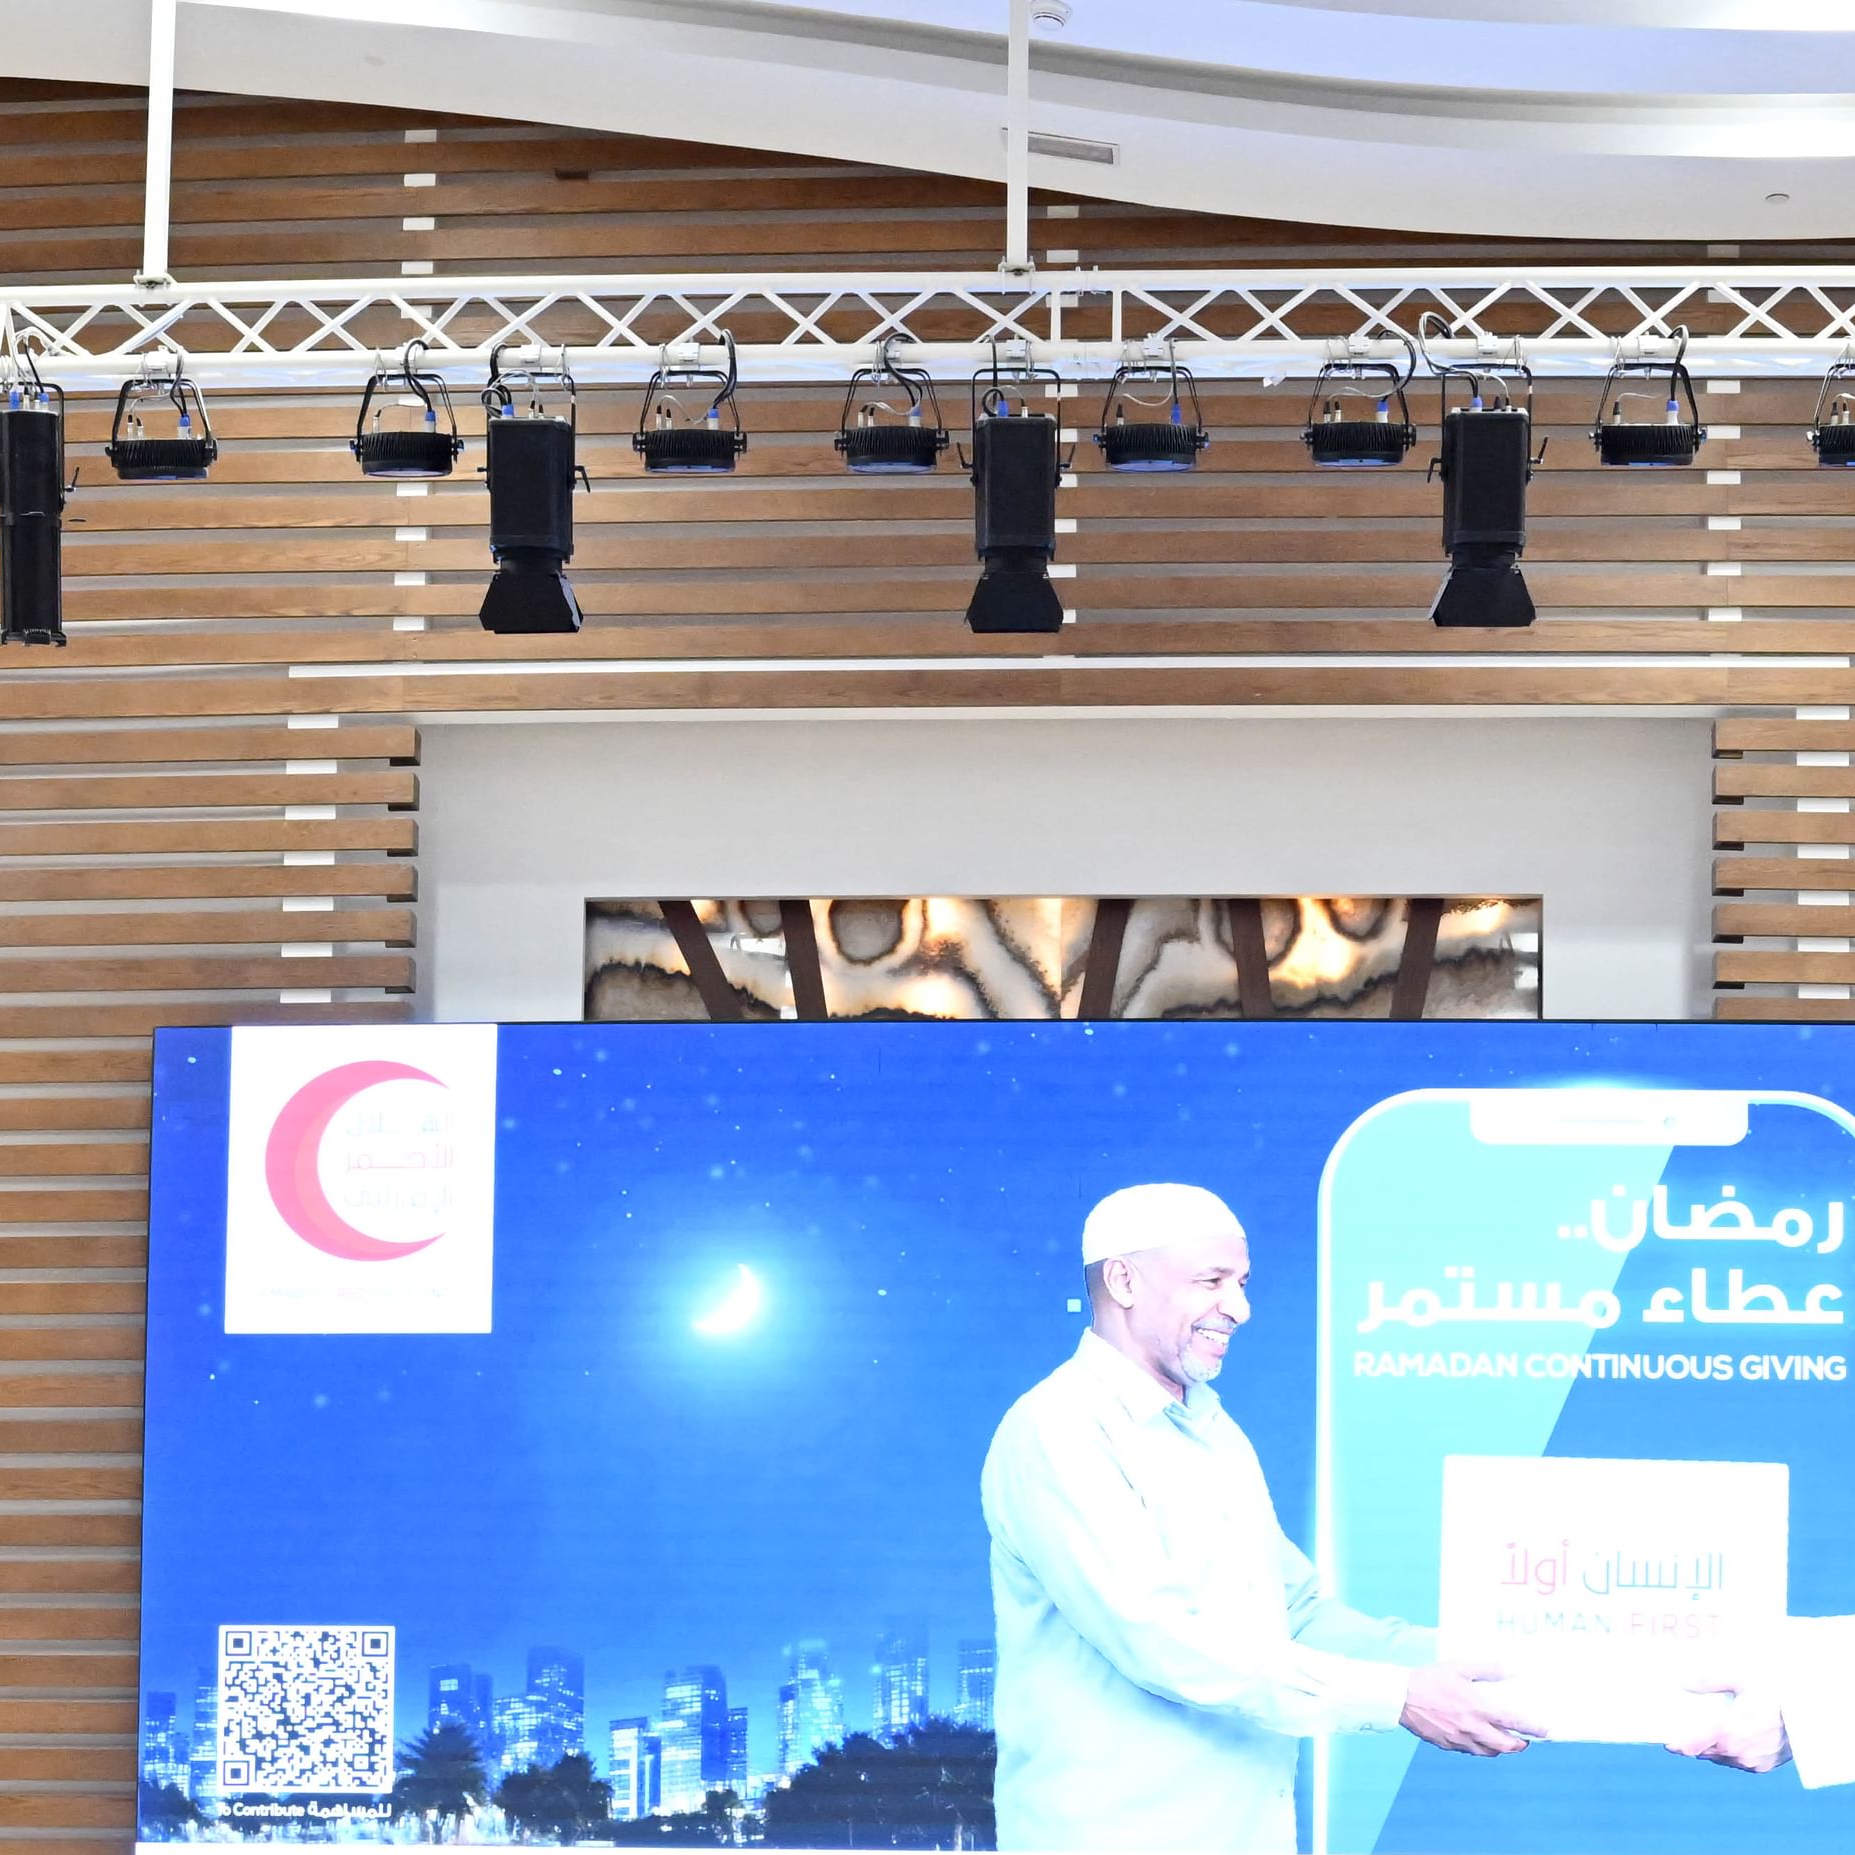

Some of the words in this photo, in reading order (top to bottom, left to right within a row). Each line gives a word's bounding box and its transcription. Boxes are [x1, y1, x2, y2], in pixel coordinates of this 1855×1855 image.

[1357, 1266, 1622, 1333] مستمر
[1641, 1267, 1845, 1325] عطاء
[1354, 1352, 1520, 1379] RAMADAN
[1524, 1354, 1733, 1380] CONTINUOUS
[1739, 1355, 1847, 1381] GIVING
[1583, 1550, 1723, 1601] الإنسان
[1498, 1611, 1612, 1635] HUMAN
[1630, 1613, 1721, 1638] FIRST
[233, 1802, 305, 1817] Contribute
[307, 1800, 392, 1819] للمساهمة
